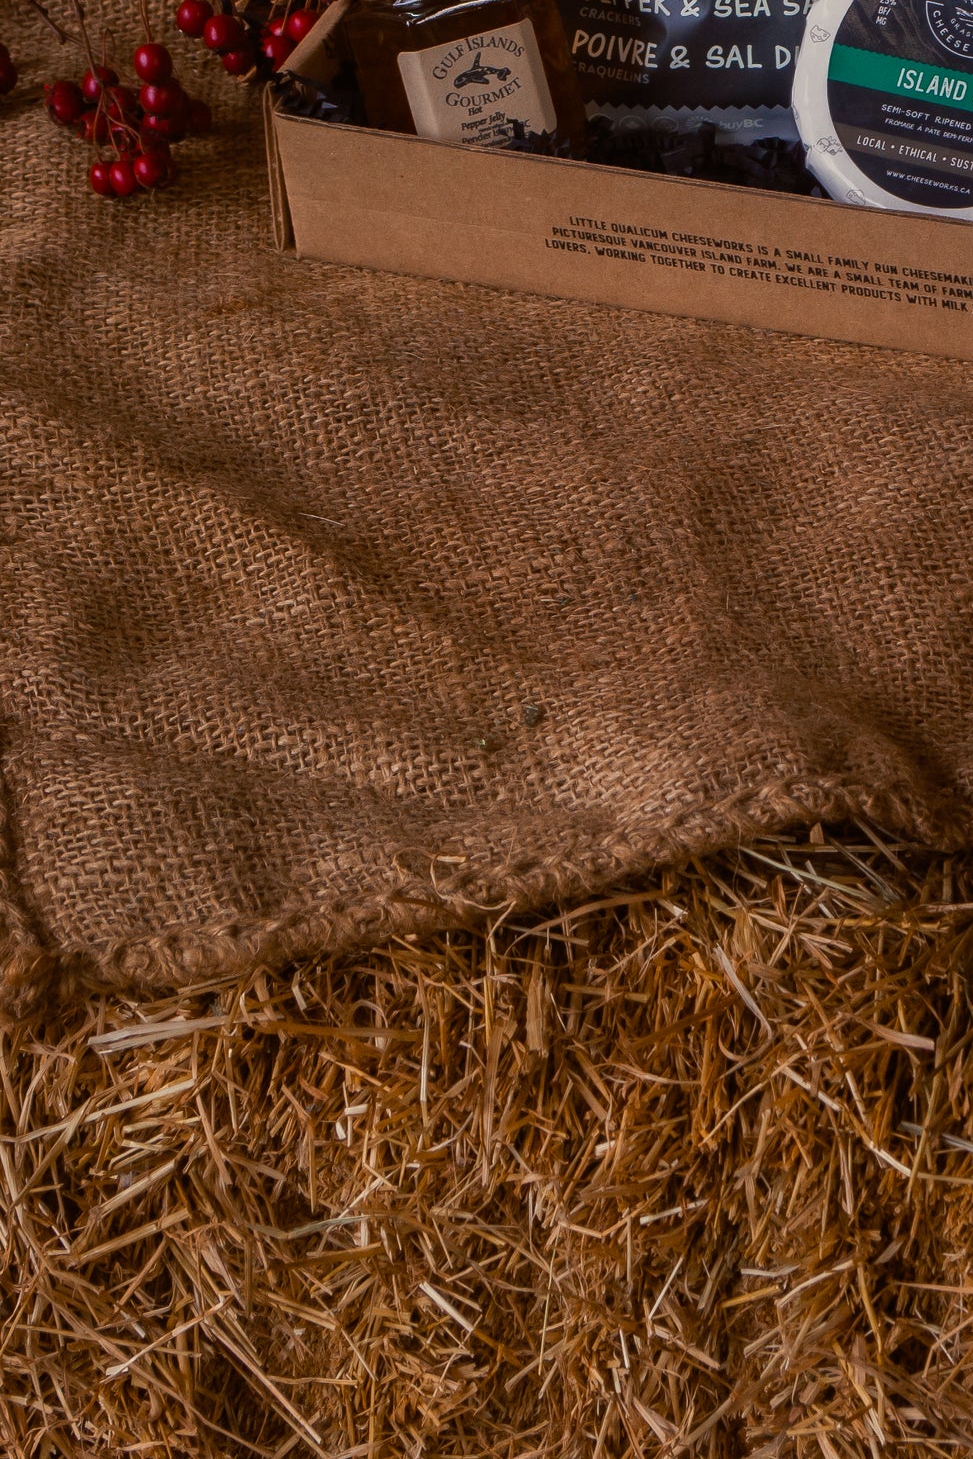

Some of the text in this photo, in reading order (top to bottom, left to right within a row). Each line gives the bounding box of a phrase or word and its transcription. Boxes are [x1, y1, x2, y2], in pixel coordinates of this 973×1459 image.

[580, 6, 641, 27] CRACKERS
[875, 16, 887, 26] MG
[432, 36, 525, 80] GULF ISLANDS
[571, 29, 800, 69] POIVRE & SAL D
[445, 77, 522, 108] GOURMET
[896, 67, 968, 102] ISLAND
[461, 118, 488, 131] Pepper
[489, 111, 506, 125] Jelly
[468, 106, 483, 117] Hot
[881, 103, 930, 121] SEMI-SOFT
[935, 116, 973, 132] RIPENED
[884, 118, 914, 130] FROMAGE
[857, 135, 887, 151] LOCAL
[899, 145, 938, 163] ETHICAL
[886, 169, 971, 195] WWW.CHEESEWORKS.CA
[569, 216, 607, 231] LITTLE
[611, 222, 668, 240] QUALICUM
[672, 232, 753, 254] CHEESEWORKS
[757, 244, 768, 256] IS
[773, 247, 782, 258] A
[786, 249, 825, 265] SMALL
[828, 256, 869, 271] FAMILY
[874, 263, 898, 275] RUN
[552, 227, 627, 248] PICTURESQUE
[631, 239, 697, 258] VANCOUVER
[701, 249, 742, 264] ISLAND
[746, 257, 781, 271] FARM.
[785, 262, 803, 274] WE
[808, 266, 829, 279] ARE
[833, 269, 842, 280] A
[846, 271, 882, 286] SMALL
[888, 278, 920, 291] TEAM
[924, 283, 937, 294] OF
[594, 245, 646, 263] WORKING
[650, 254, 706, 272] TOGETHER
[710, 263, 725, 275] TO
[729, 266, 772, 282] CREATE
[775, 274, 837, 292] EXCELLENT
[841, 283, 902, 302] PRODUCTS
[906, 294, 937, 307] WITH
[941, 299, 968, 313] MILK
